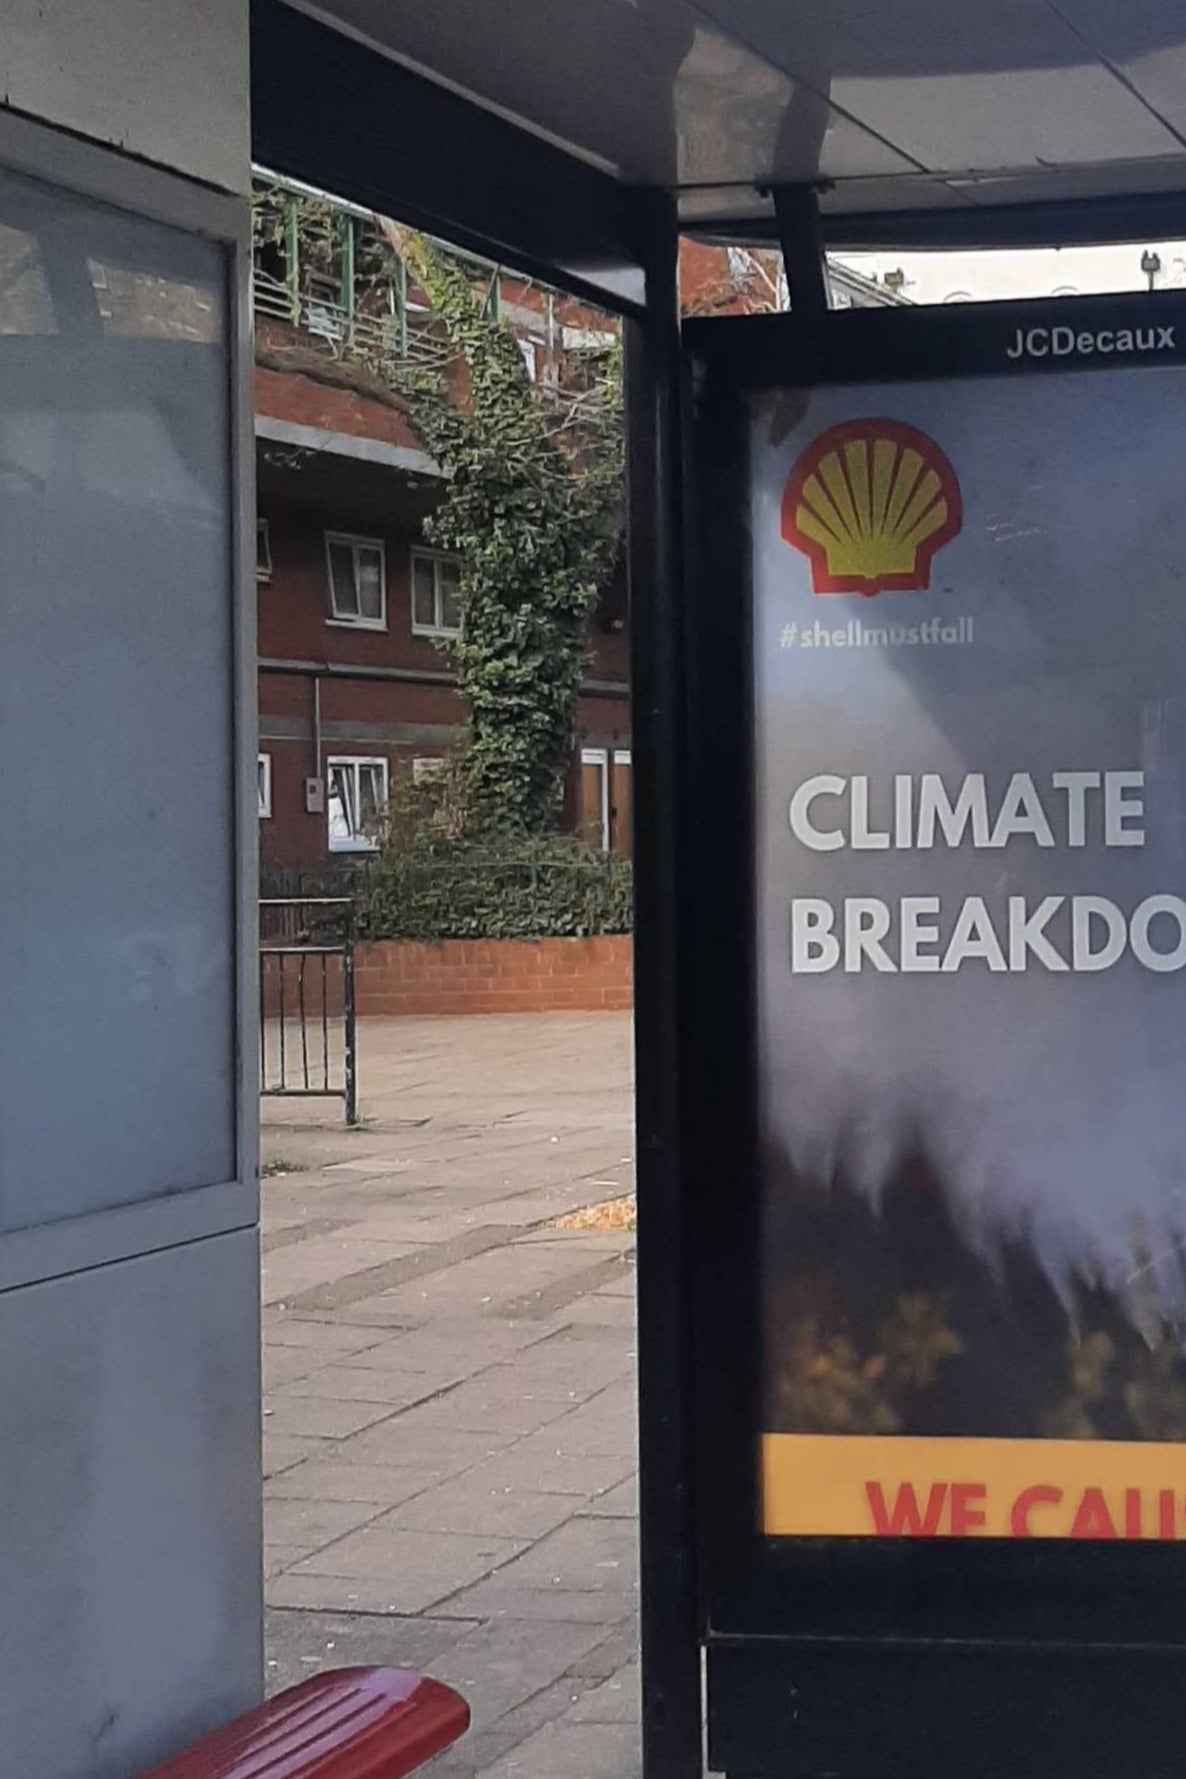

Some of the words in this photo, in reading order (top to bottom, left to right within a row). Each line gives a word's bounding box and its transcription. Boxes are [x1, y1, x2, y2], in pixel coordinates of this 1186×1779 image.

[1007, 326, 1175, 358] JCDecaux
[780, 616, 975, 648] #shellmustfall
[789, 771, 1146, 852] CLIMATE
[865, 1480, 988, 1537] WE
